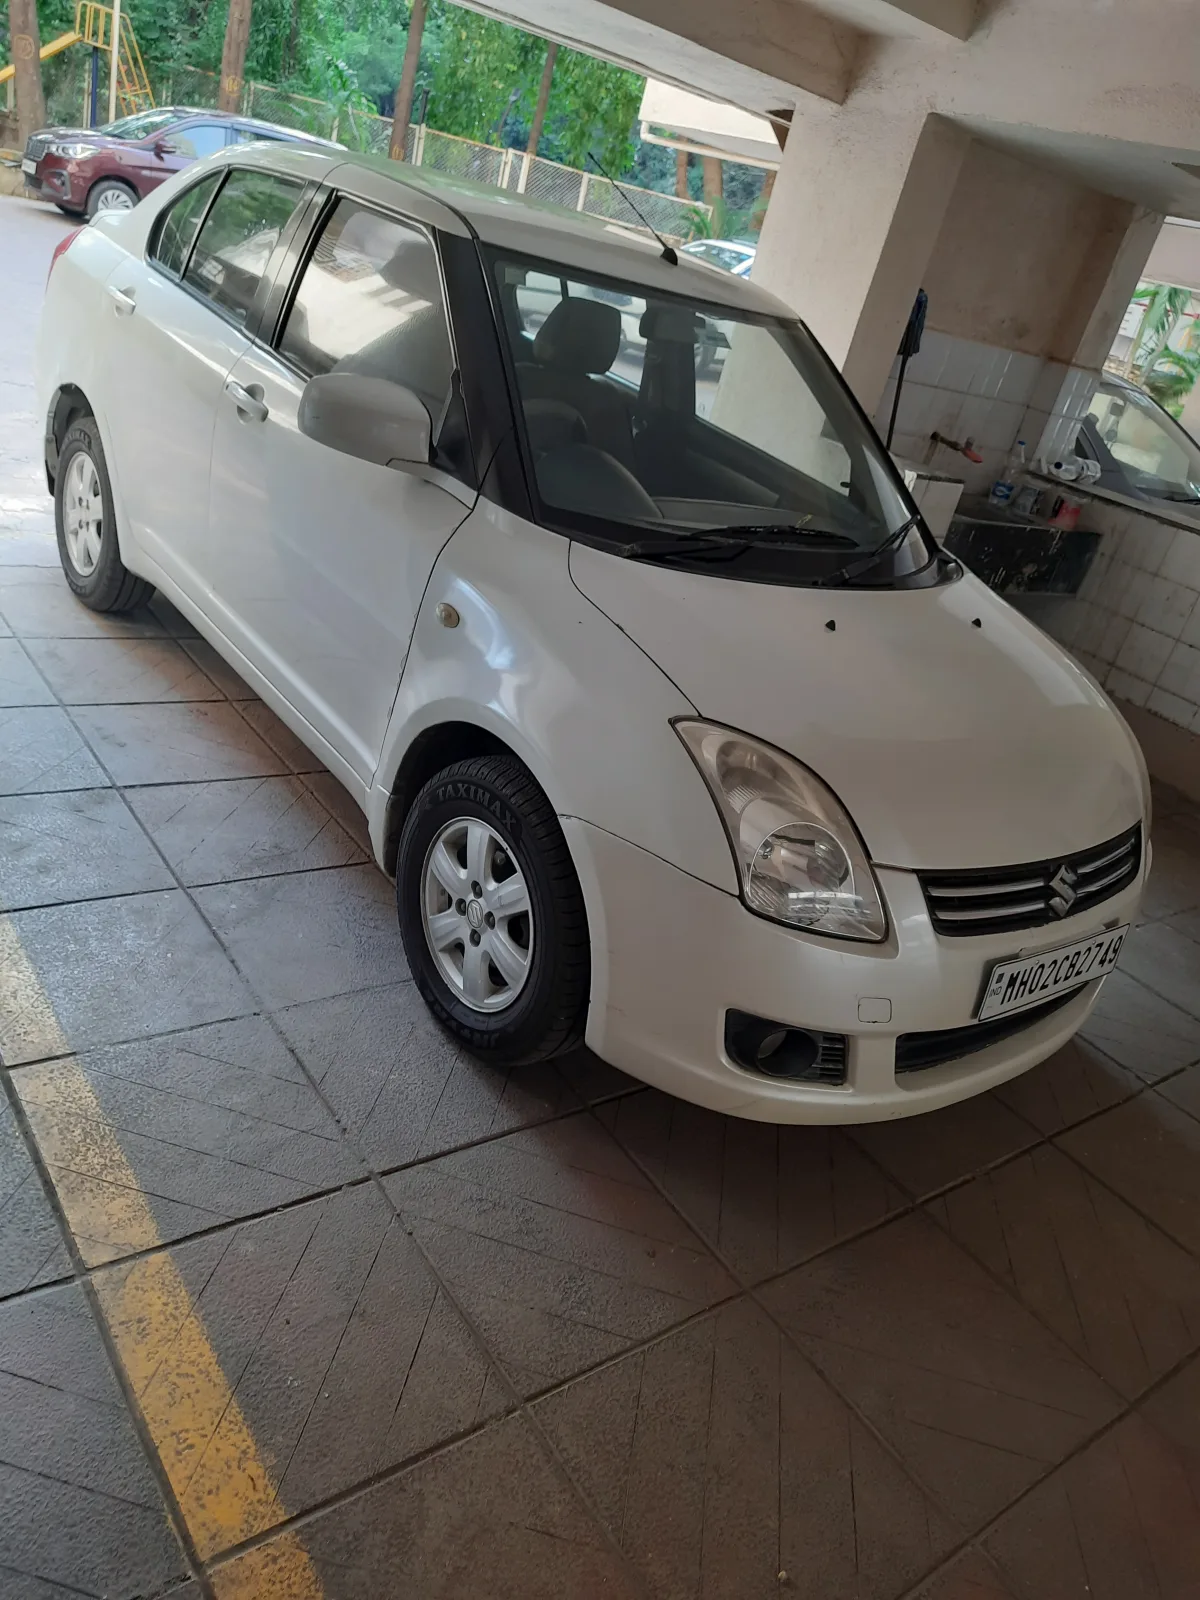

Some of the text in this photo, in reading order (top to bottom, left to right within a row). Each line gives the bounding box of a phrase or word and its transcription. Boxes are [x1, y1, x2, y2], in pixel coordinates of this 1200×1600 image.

[437, 783, 517, 832] TAXIMAX
[988, 986, 1002, 998] IND
[1000, 934, 1124, 1005] MH02CB2749
